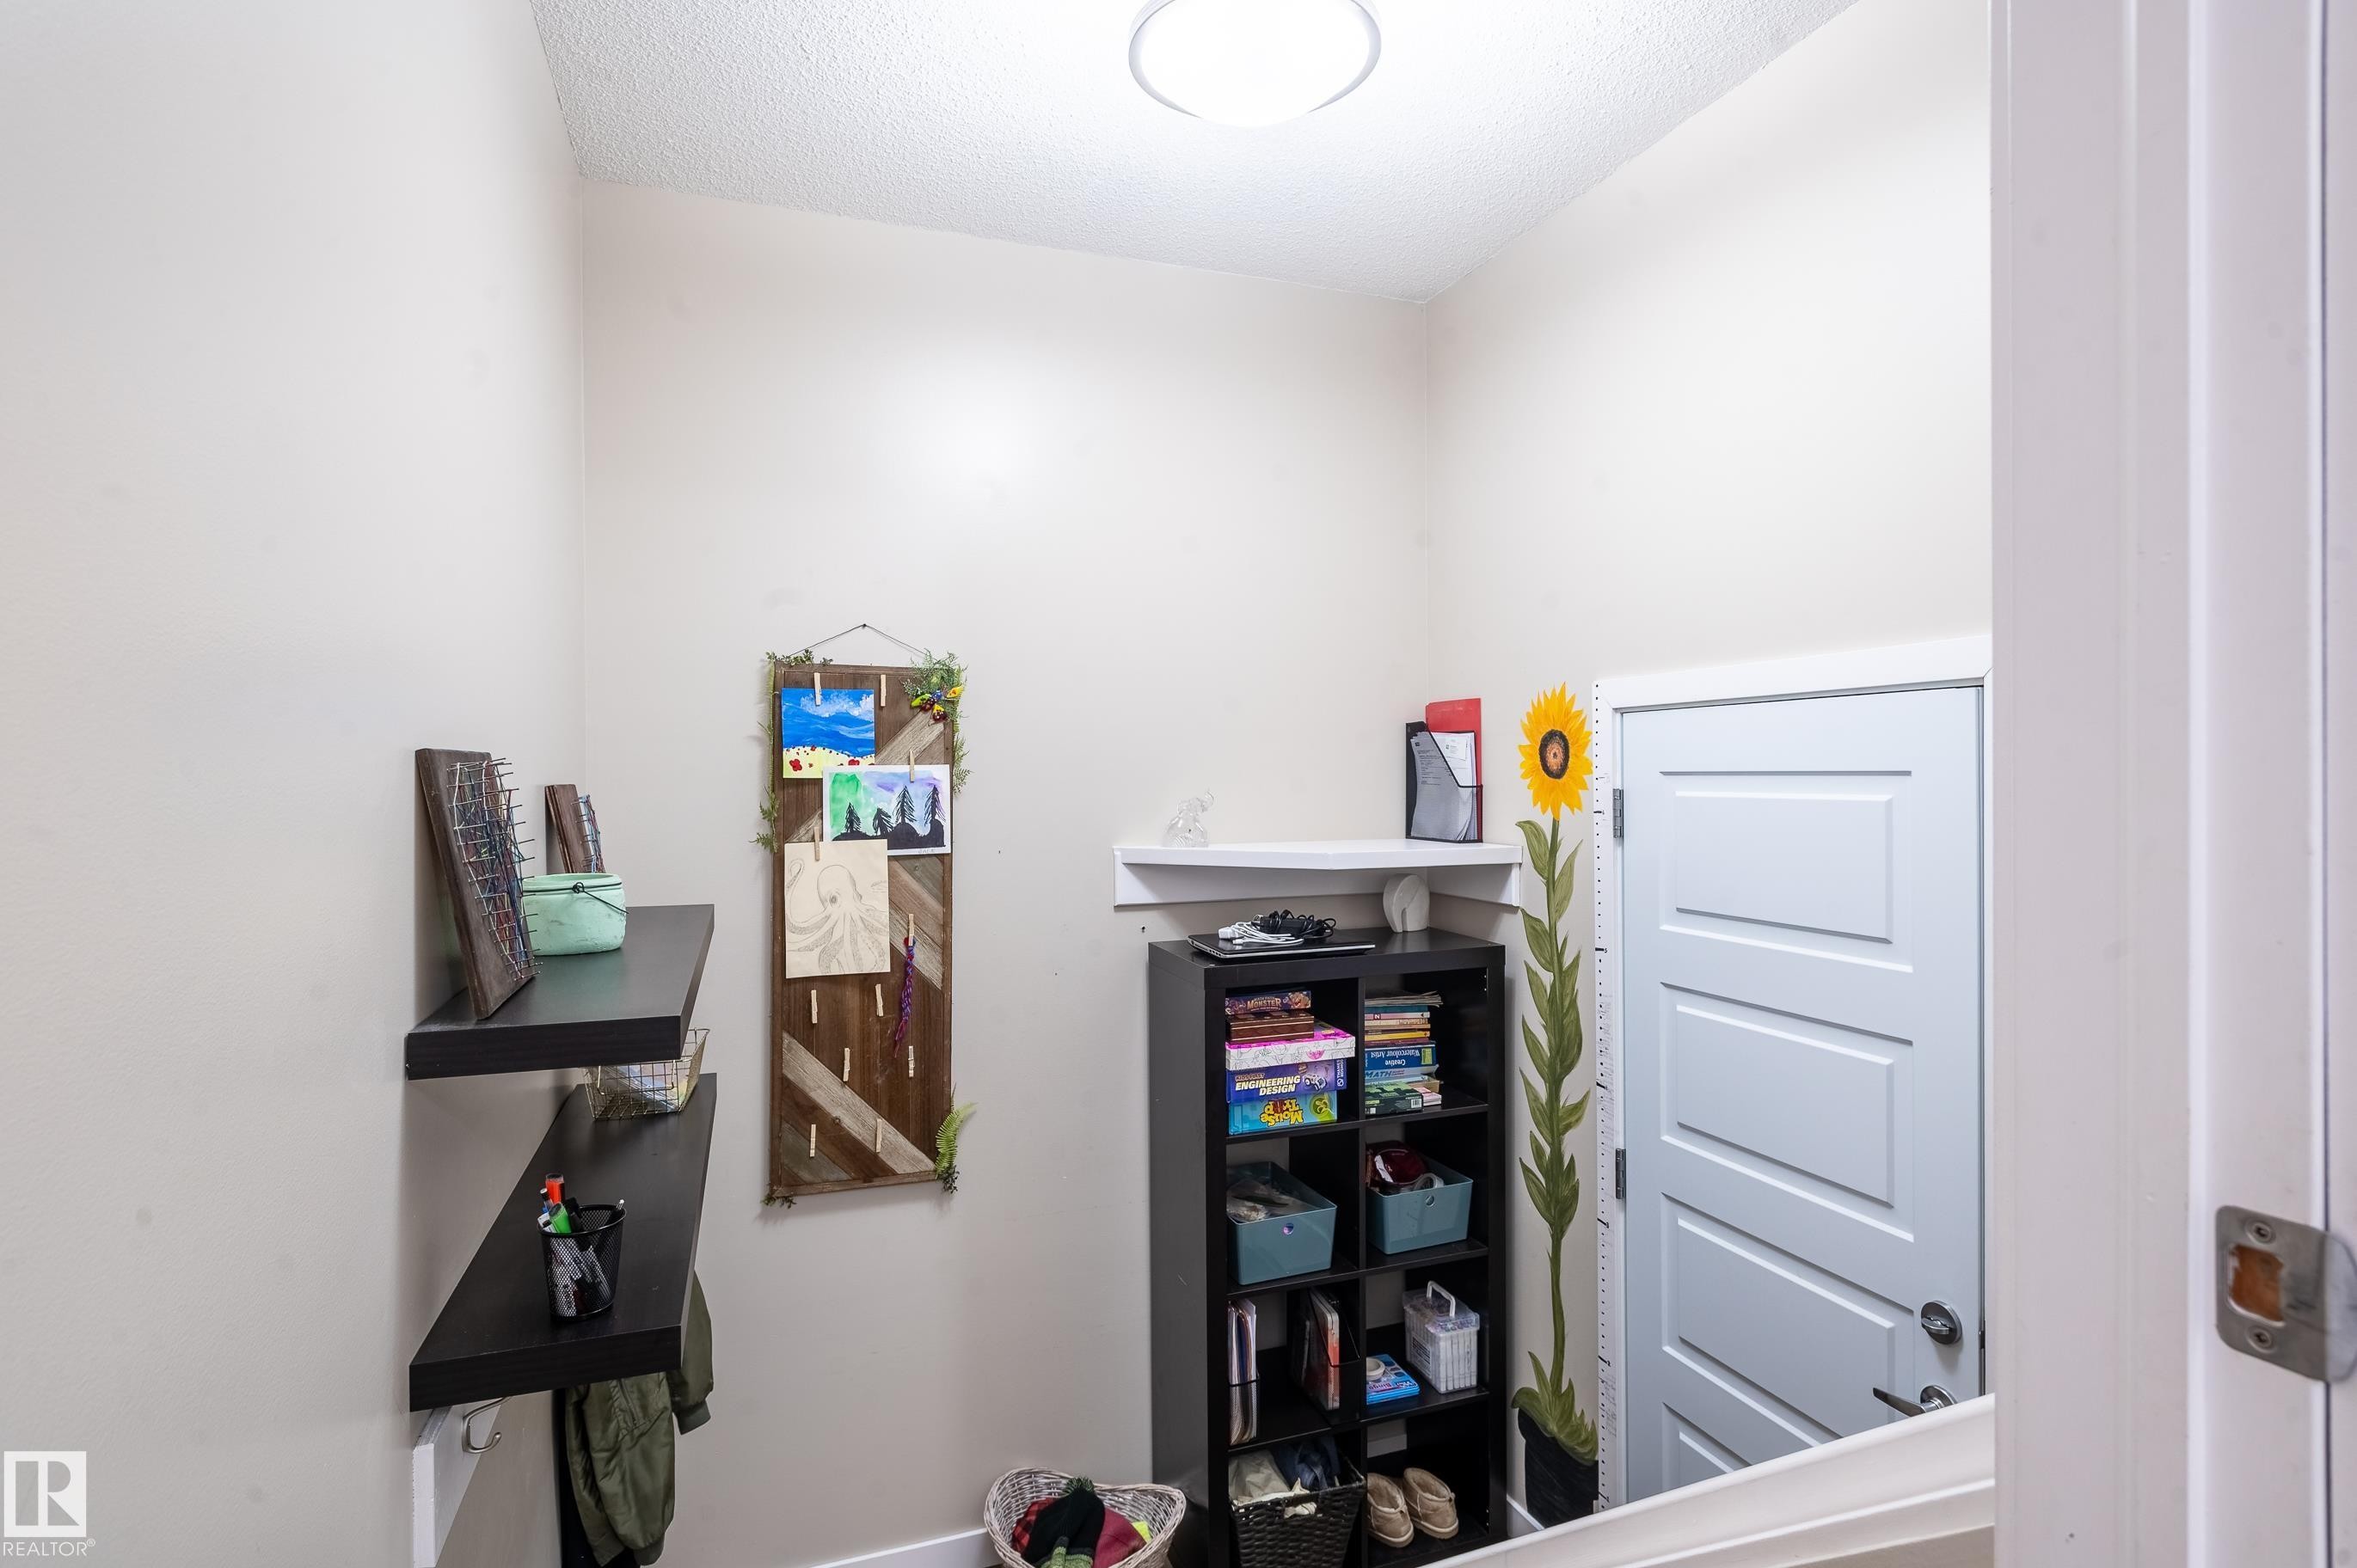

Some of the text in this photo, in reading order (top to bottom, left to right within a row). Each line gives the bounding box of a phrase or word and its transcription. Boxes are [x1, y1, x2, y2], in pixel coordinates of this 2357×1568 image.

[1247, 998, 1282, 1010] MONSTER
[1236, 1075, 1300, 1091] ENGINEERING
[1259, 1084, 1296, 1096] DESIGN
[1265, 1099, 1299, 1114] Trp
[1260, 1110, 1304, 1127] Mouse
